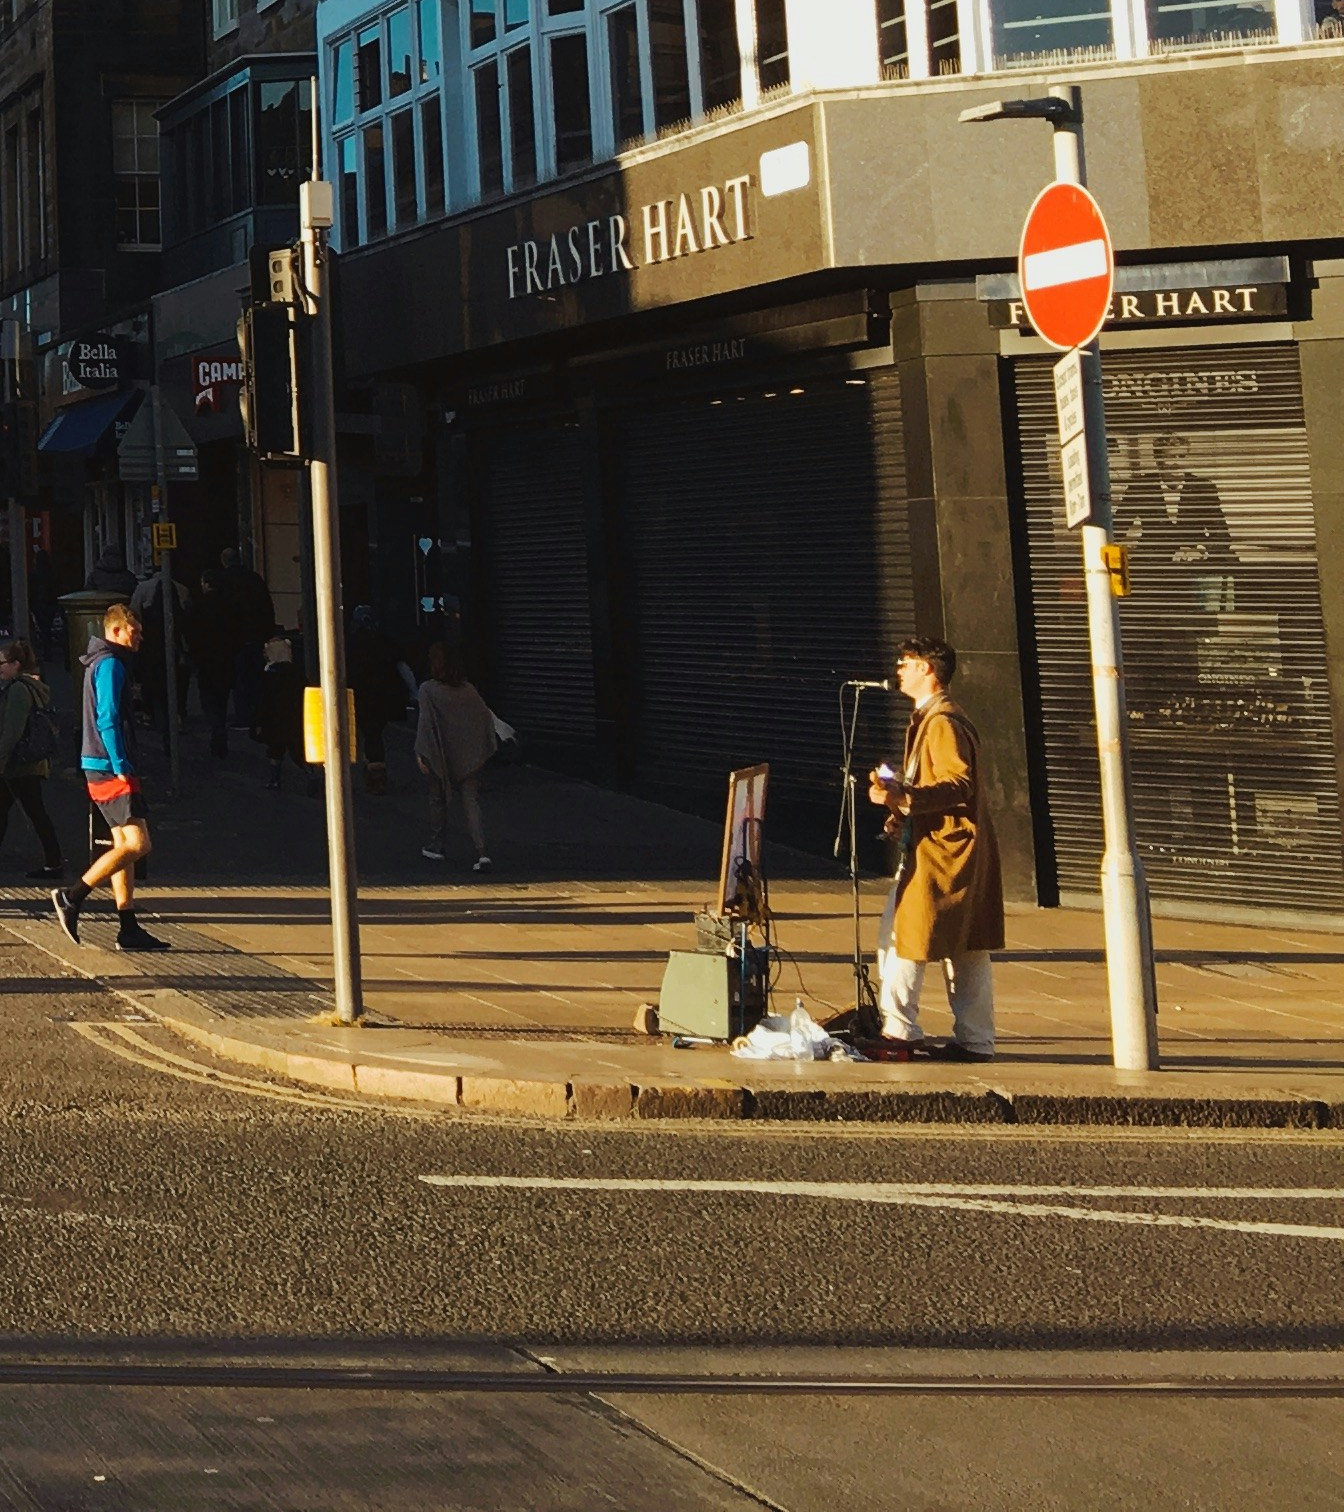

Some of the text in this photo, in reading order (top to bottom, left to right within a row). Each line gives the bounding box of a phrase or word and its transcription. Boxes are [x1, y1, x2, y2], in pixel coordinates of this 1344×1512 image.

[506, 173, 751, 299] FRASER HART
[1009, 287, 1258, 325] FER HART
[78, 343, 117, 360] Bella
[666, 338, 747, 370] FRASER HART
[78, 362, 119, 378] Italia
[468, 380, 526, 407] FRASER HART
